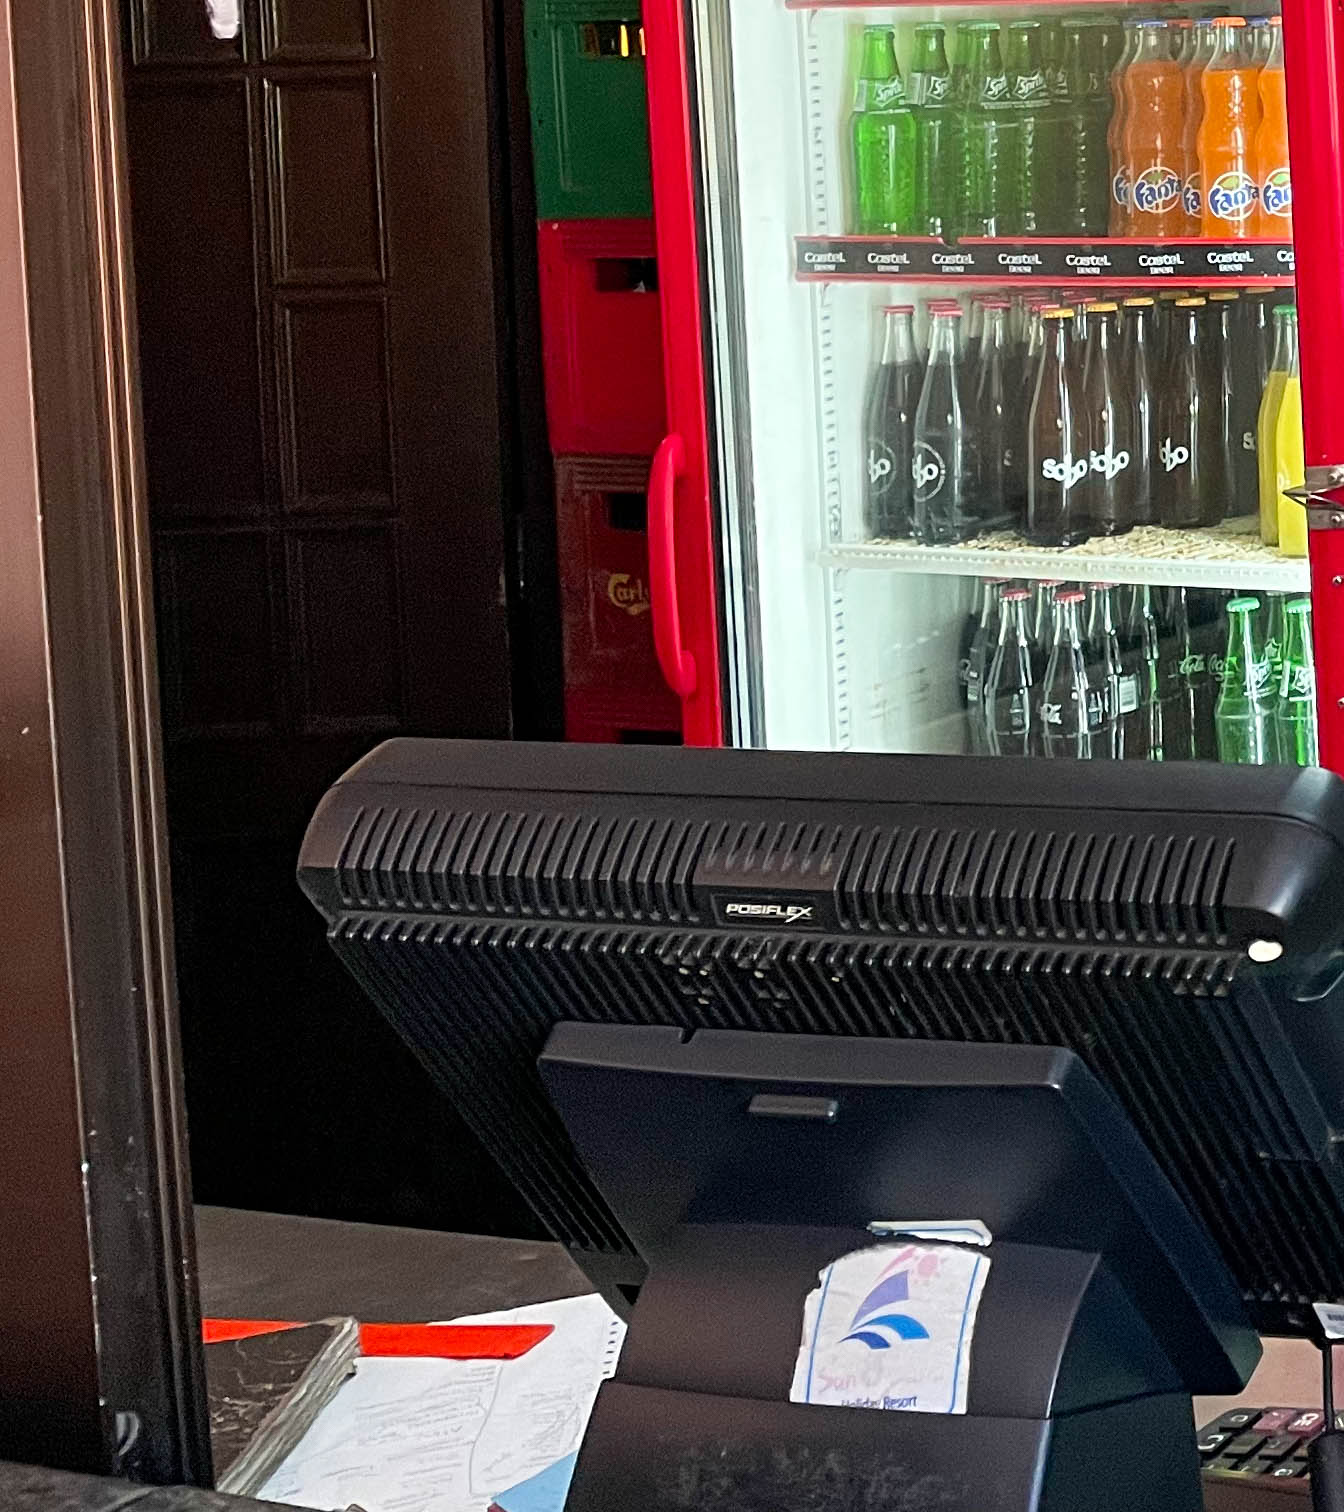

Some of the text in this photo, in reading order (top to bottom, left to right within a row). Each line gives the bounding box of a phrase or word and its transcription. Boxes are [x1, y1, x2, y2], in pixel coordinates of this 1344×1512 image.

[1135, 177, 1183, 212] Fanta
[1209, 185, 1260, 218] Fanta
[726, 903, 813, 923] POSIFLEX
[883, 1396, 918, 1408] Resort
